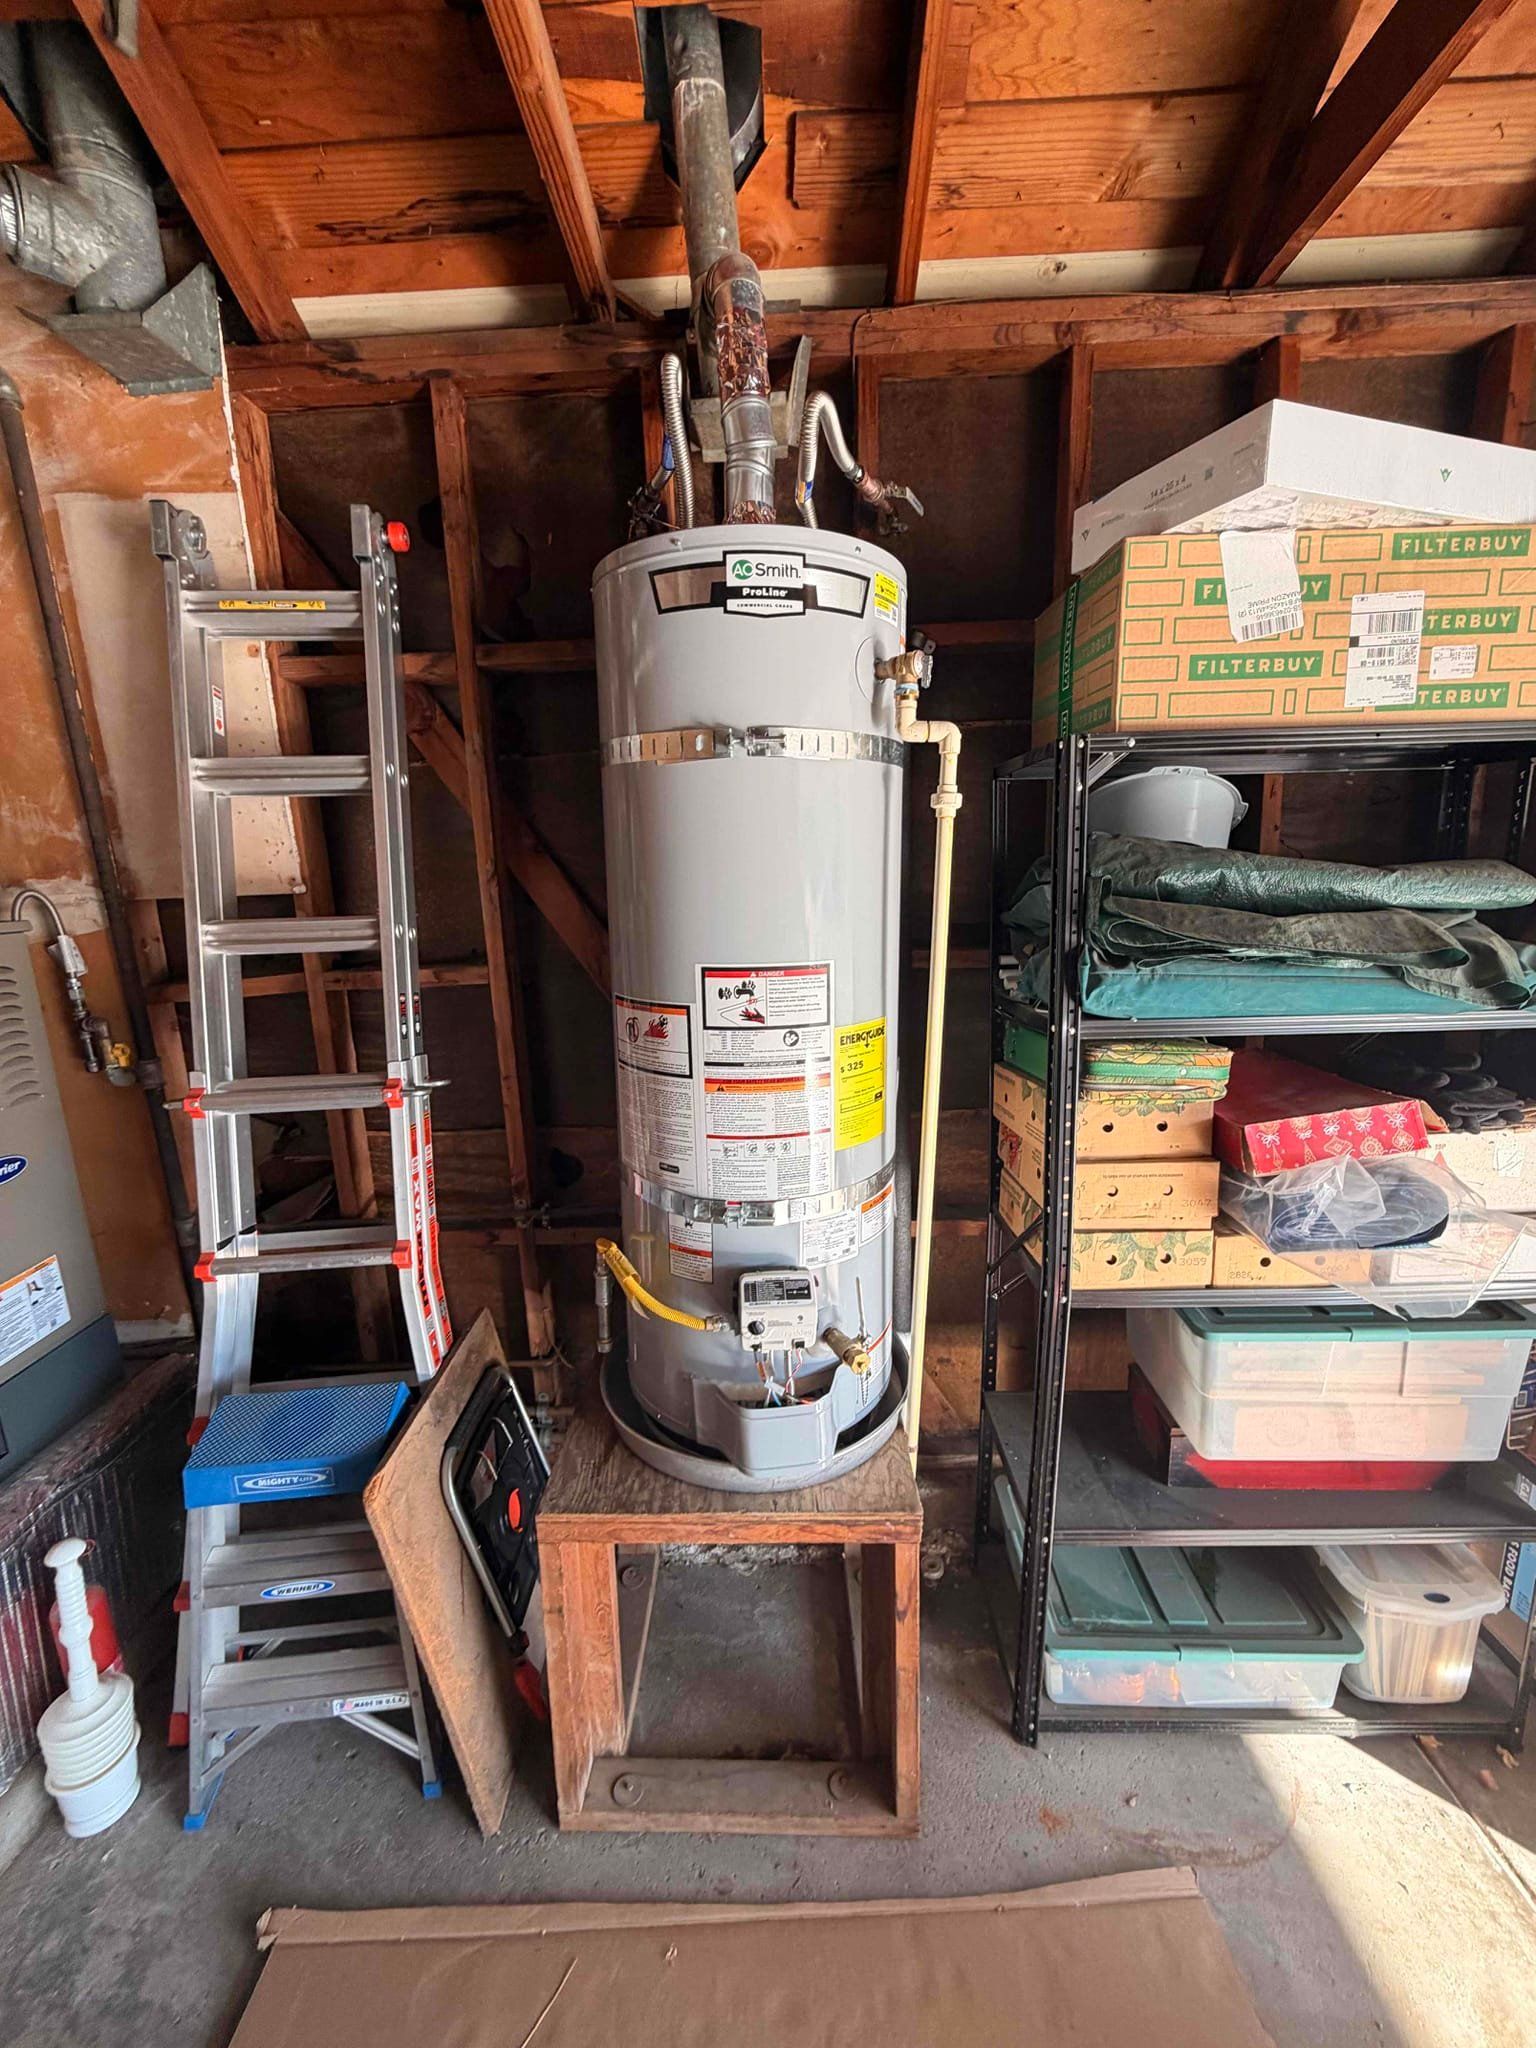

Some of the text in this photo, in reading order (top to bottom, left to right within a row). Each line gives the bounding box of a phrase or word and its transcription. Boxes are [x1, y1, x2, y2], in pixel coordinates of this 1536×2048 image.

[1400, 535, 1523, 554] FILTERBUY
[742, 587, 786, 598] ProLine
[1197, 656, 1317, 675] FILTERBUY
[847, 1060, 864, 1072] 325
[1178, 1257, 1207, 1266] 3059
[257, 1476, 299, 1487] MIGHTY
[1506, 1549, 1519, 1579] FOOD
[276, 1583, 321, 1596] WERNER
